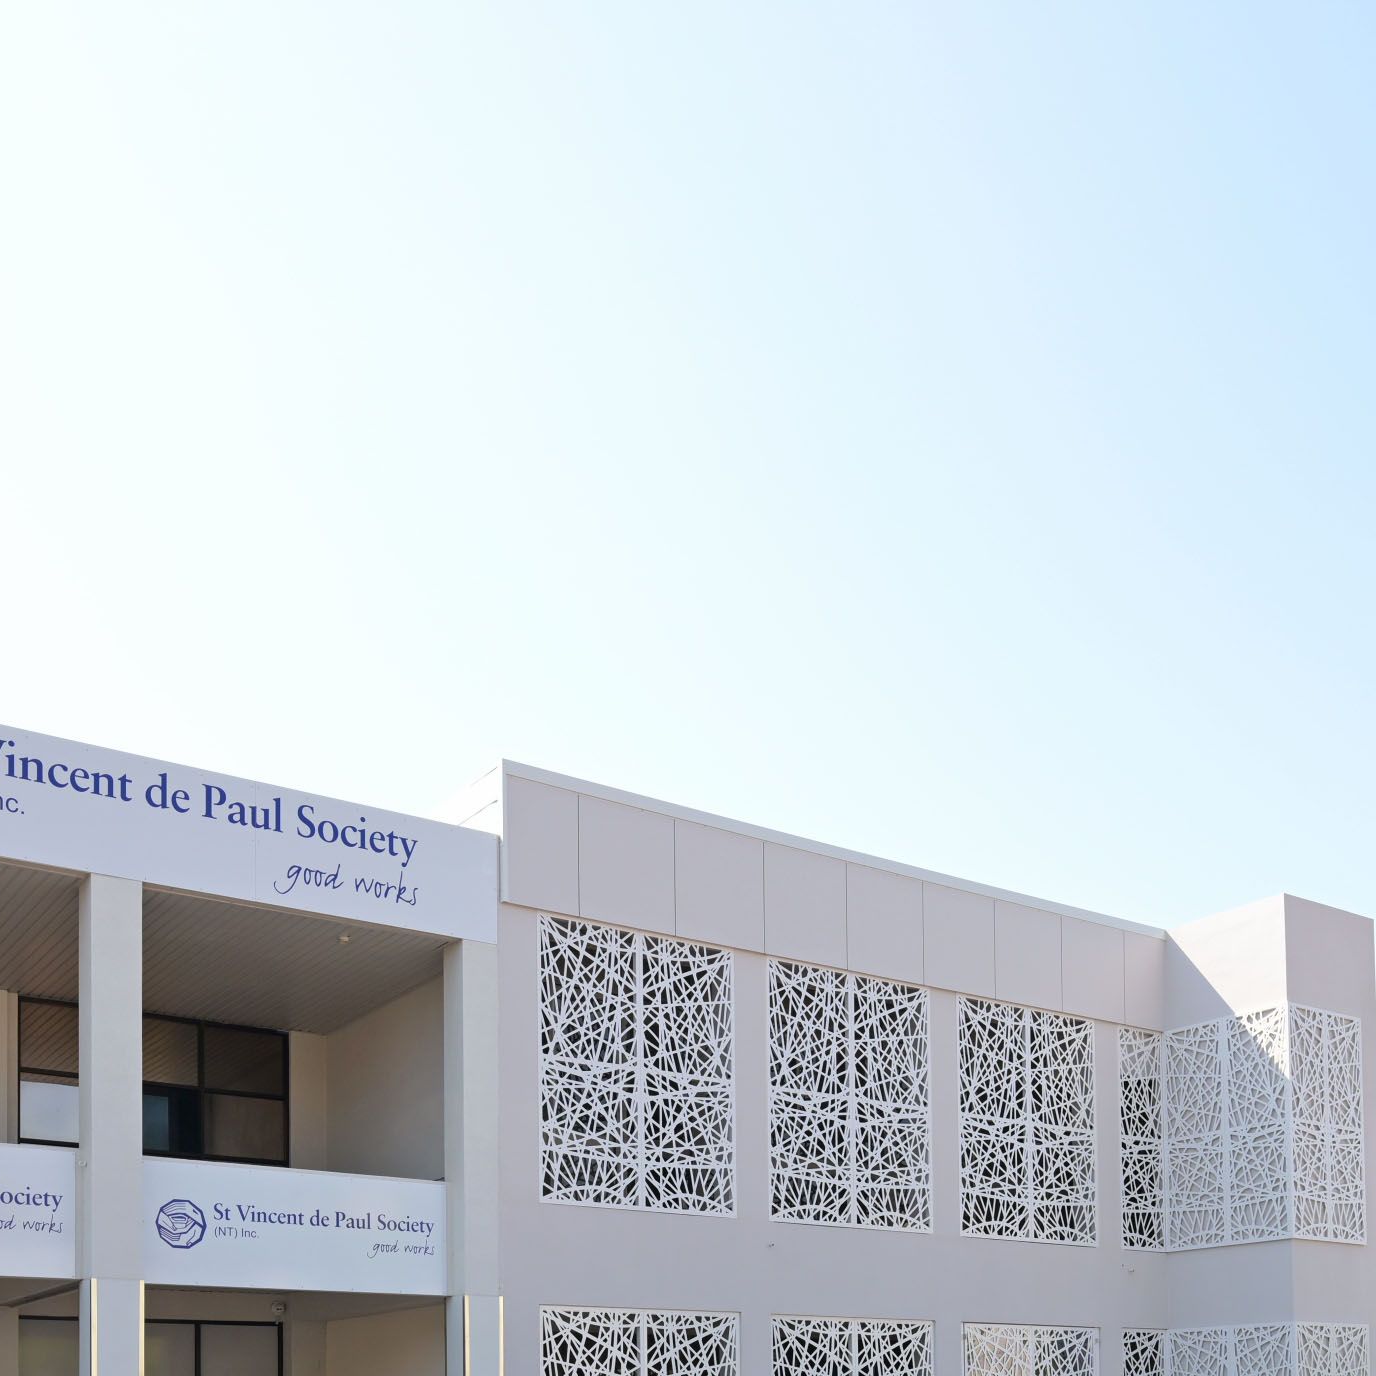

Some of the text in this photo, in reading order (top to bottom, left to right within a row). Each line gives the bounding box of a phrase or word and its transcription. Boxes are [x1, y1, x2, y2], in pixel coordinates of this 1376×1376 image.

[145, 772, 191, 814] de
[202, 784, 284, 834] Paul
[297, 804, 419, 868] Society
[274, 862, 419, 906] good works
[22, 1215, 64, 1234] works
[213, 1202, 434, 1238] St Vincent de Paul Society
[214, 1226, 260, 1239] (NT) Inc.
[367, 1239, 435, 1259] good works
